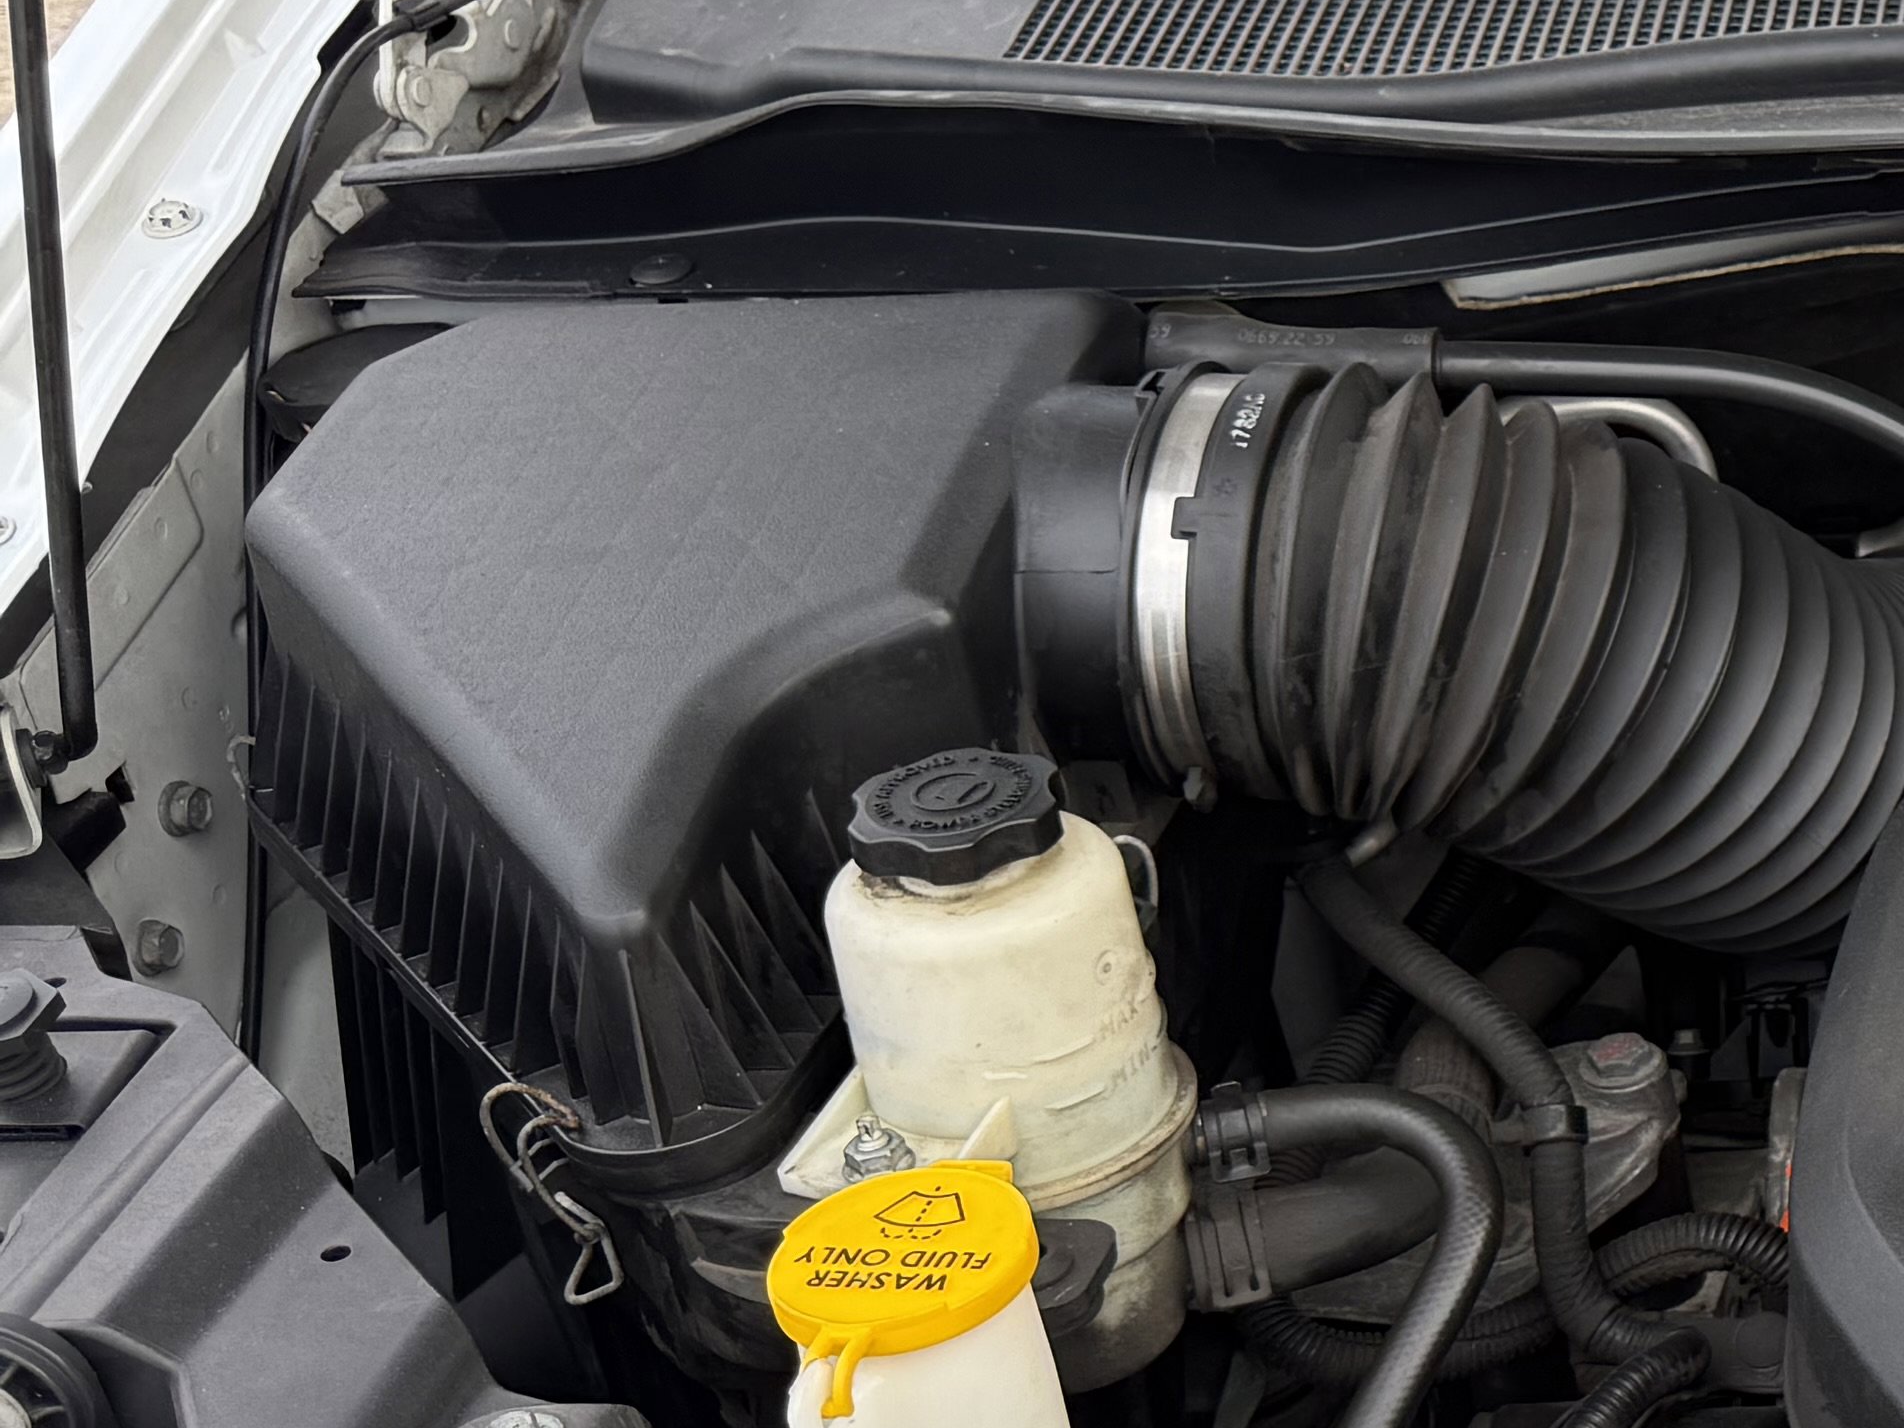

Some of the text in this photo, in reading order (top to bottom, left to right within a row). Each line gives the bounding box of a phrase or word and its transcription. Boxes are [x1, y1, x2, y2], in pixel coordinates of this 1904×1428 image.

[793, 1245, 992, 1270] FLUID ONLY
[806, 1269, 947, 1291] WASHER
